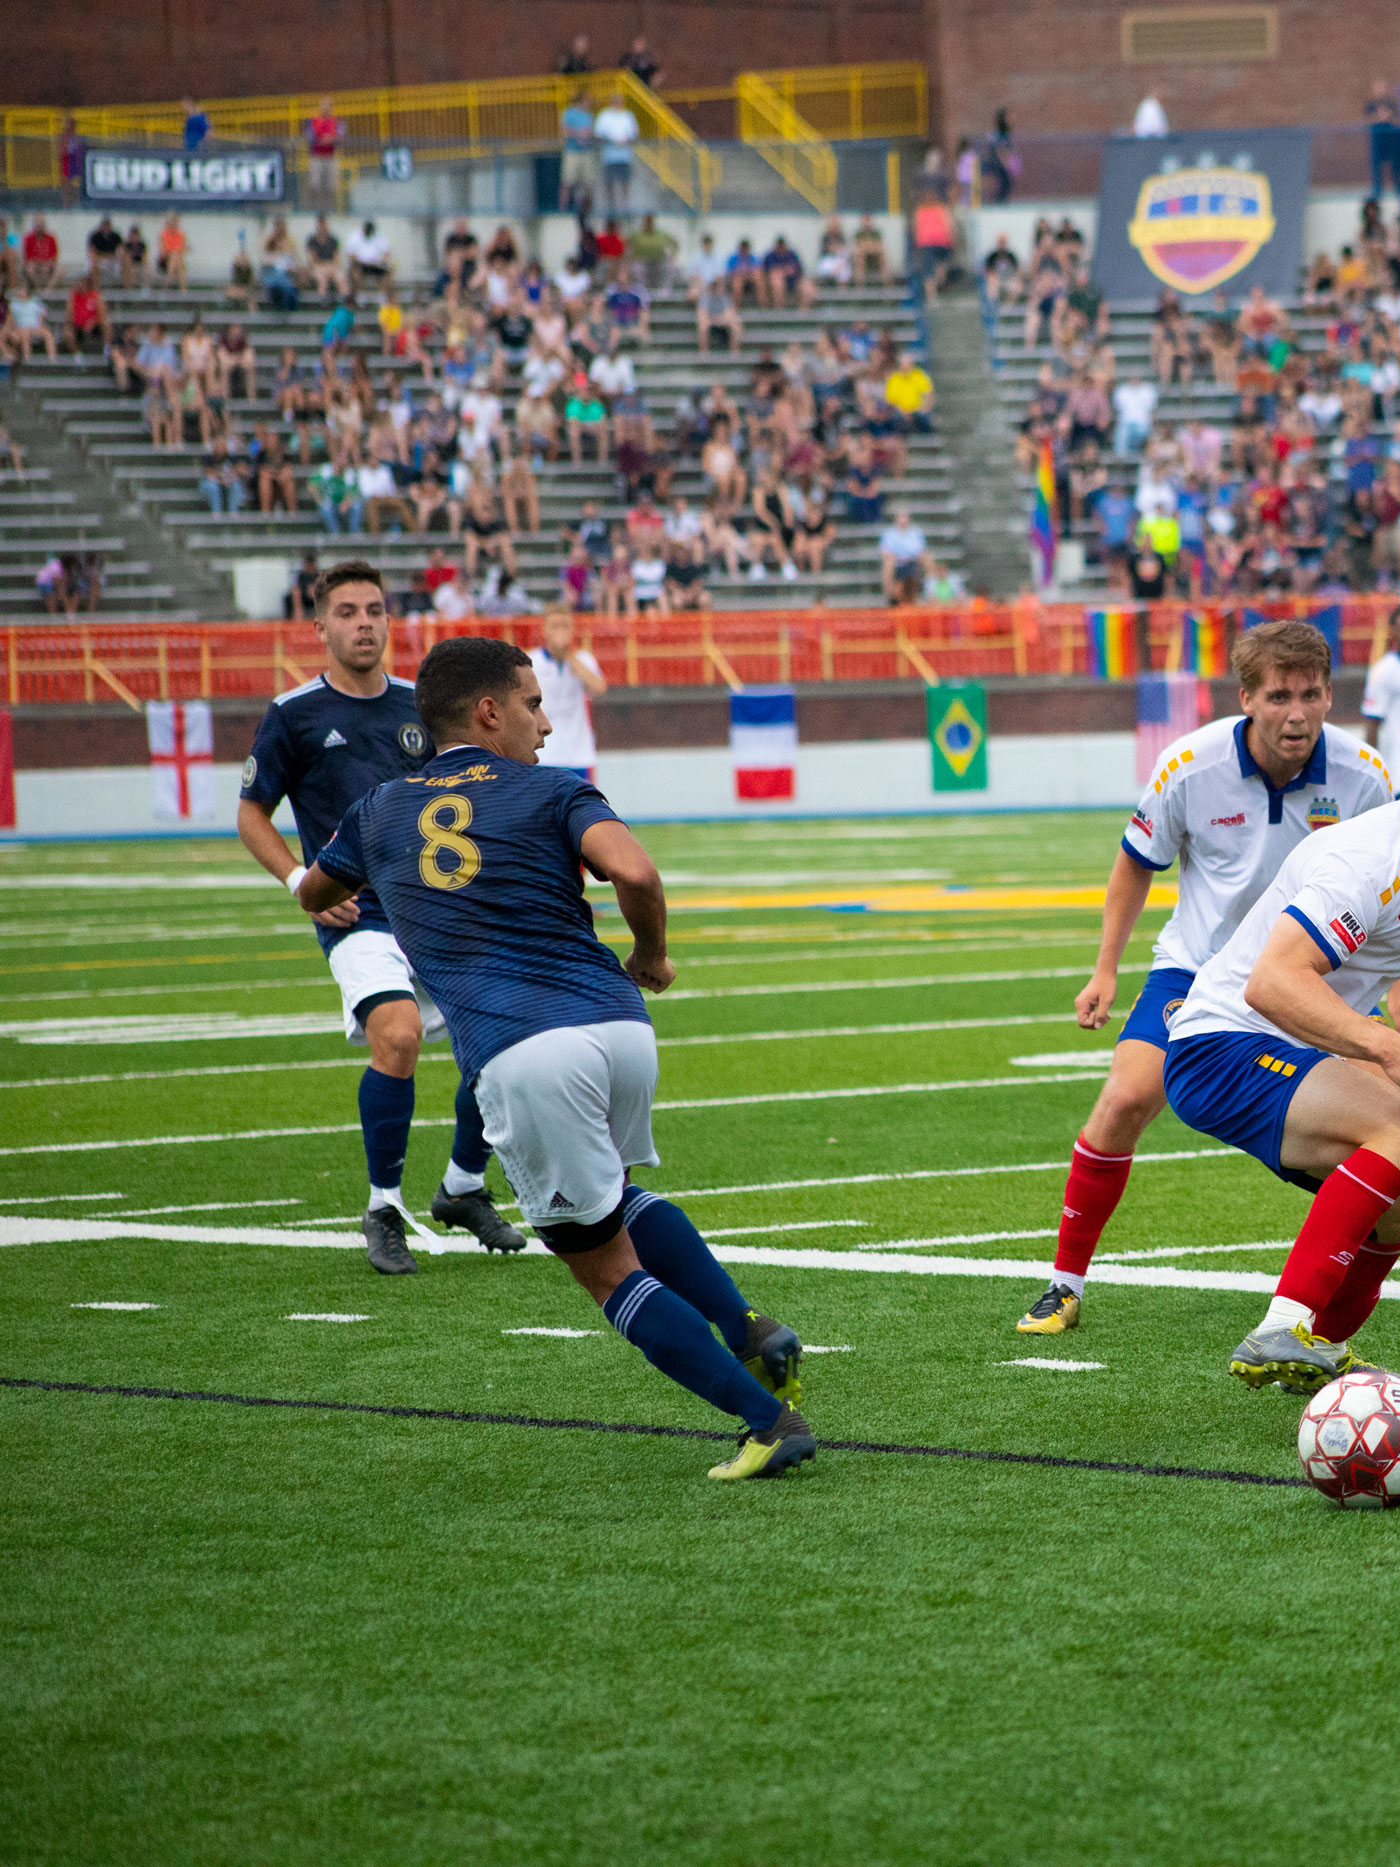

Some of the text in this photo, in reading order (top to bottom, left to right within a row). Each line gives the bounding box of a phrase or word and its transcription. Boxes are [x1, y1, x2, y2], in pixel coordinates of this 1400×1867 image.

[93, 157, 274, 194] BUD LIGHT
[418, 793, 482, 891] 8
